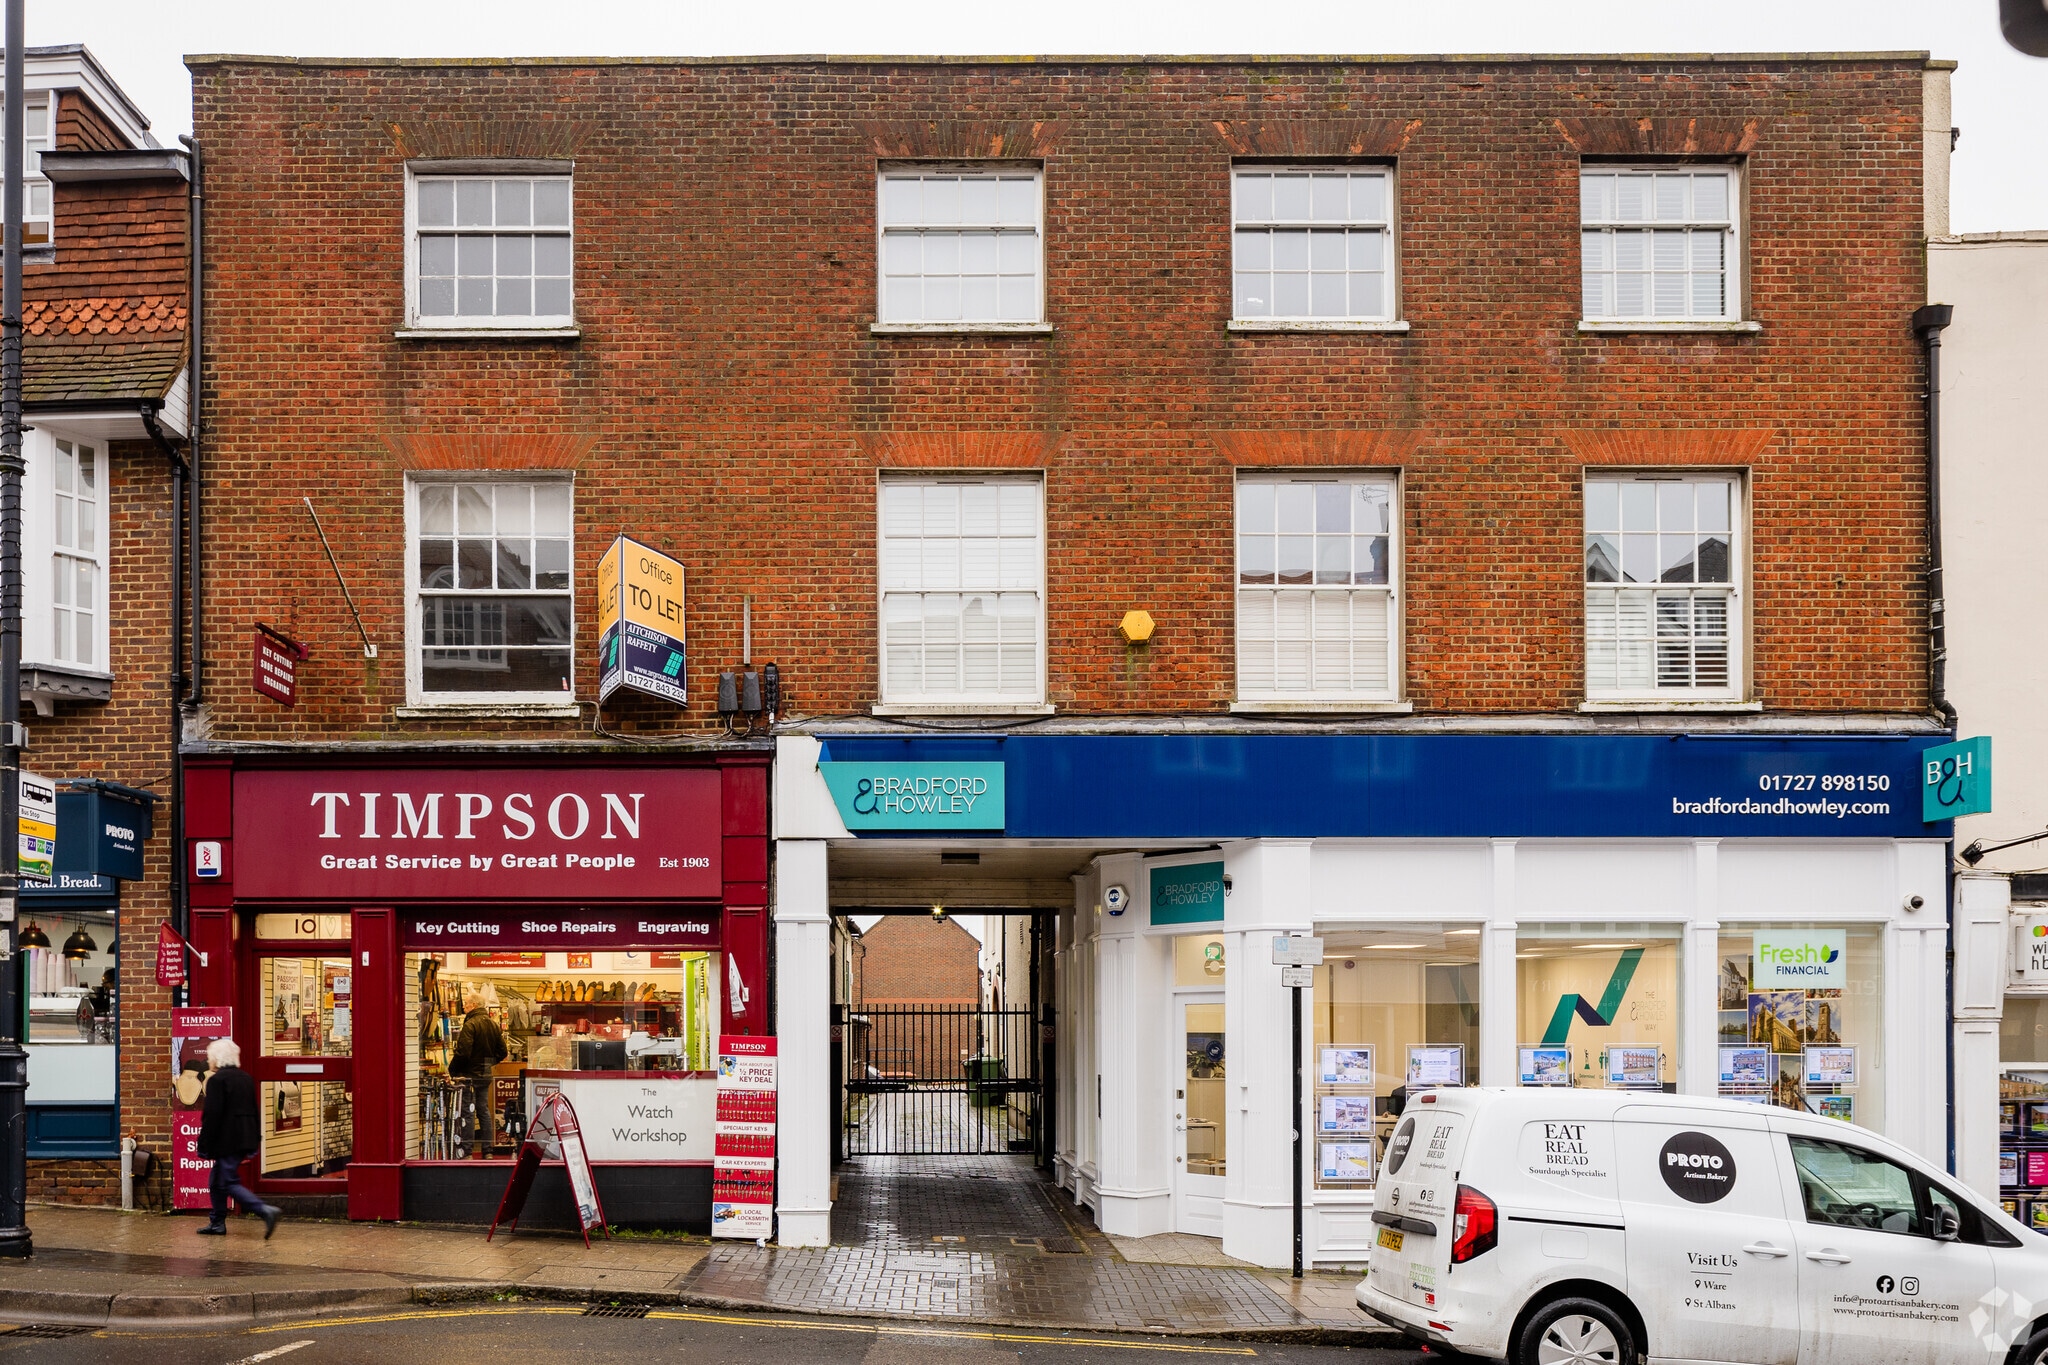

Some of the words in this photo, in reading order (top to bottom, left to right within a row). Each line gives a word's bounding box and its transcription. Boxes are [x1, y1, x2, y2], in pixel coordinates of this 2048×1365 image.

[640, 557, 672, 585] Office
[606, 583, 618, 614] LET
[628, 583, 652, 611] TO
[658, 595, 682, 624] LET
[627, 624, 668, 644] AITCHISON
[627, 636, 658, 653] RAFFETY
[262, 646, 272, 658] KEY
[273, 652, 292, 670] CUTTING
[260, 659, 273, 673] SHOE
[274, 666, 294, 684] REPAIRS
[264, 675, 290, 696] ENGRAVING
[628, 673, 654, 688] 01727
[656, 681, 671, 695] 843
[672, 686, 685, 700] 232
[1759, 775, 1816, 791] 01727
[1821, 775, 1890, 791] 898150
[1928, 752, 1972, 806] B&H
[854, 778, 880, 814] &
[874, 777, 987, 795] BRADFORD
[885, 796, 976, 812] HOWLEY
[1672, 797, 1890, 818] bradfordandhowley.com
[310, 793, 645, 840] TIMPSON
[106, 824, 134, 841] PROTO
[320, 854, 377, 869] Great
[385, 854, 462, 869] Service
[469, 854, 493, 872] by
[501, 853, 558, 869] Great
[565, 853, 635, 872] People
[659, 857, 677, 868] Est
[681, 857, 710, 868] 1903
[60, 875, 101, 888] Bread.
[1165, 881, 1220, 896] BRADFORD
[1171, 892, 1214, 905] HOWLEY
[295, 918, 316, 933] 10
[416, 922, 444, 936] Key
[447, 922, 500, 936] Cutting
[521, 922, 557, 933] Shoe
[562, 922, 616, 936] Repairs
[638, 922, 710, 935] Engraving
[1760, 943, 1818, 964] Fresh
[2032, 942, 2048, 954] wi
[1776, 966, 1829, 975] FINANCIAL
[497, 1081, 515, 1089] Car
[537, 1087, 546, 1095] HALF
[641, 1088, 657, 1096] The
[627, 1105, 673, 1119] Watch
[612, 1128, 686, 1145] Workshop
[1434, 1125, 1453, 1139] EAT
[1544, 1124, 1586, 1140] EAT
[1429, 1139, 1447, 1150] REAL
[1545, 1142, 1588, 1154] REAL
[1427, 1150, 1445, 1158] BREAD
[1546, 1154, 1588, 1166] BREAD
[1667, 1152, 1723, 1169] PROTO
[1529, 1166, 1570, 1178] Sourdough
[1572, 1168, 1606, 1179] Specialist
[1684, 1171, 1705, 1179] Artisan
[1706, 1173, 1728, 1182] Bakery
[1687, 1252, 1718, 1266] Visit
[1722, 1254, 1738, 1268] Us
[1410, 1271, 1436, 1285] ELECTRIC
[1704, 1281, 1726, 1291] Ware
[1693, 1299, 1704, 1309] St
[1706, 1300, 1736, 1310] Albans
[1833, 1294, 1960, 1311] info@protoartisanbakery.com
[1833, 1308, 1959, 1323] www.protoartisanbakery.com
